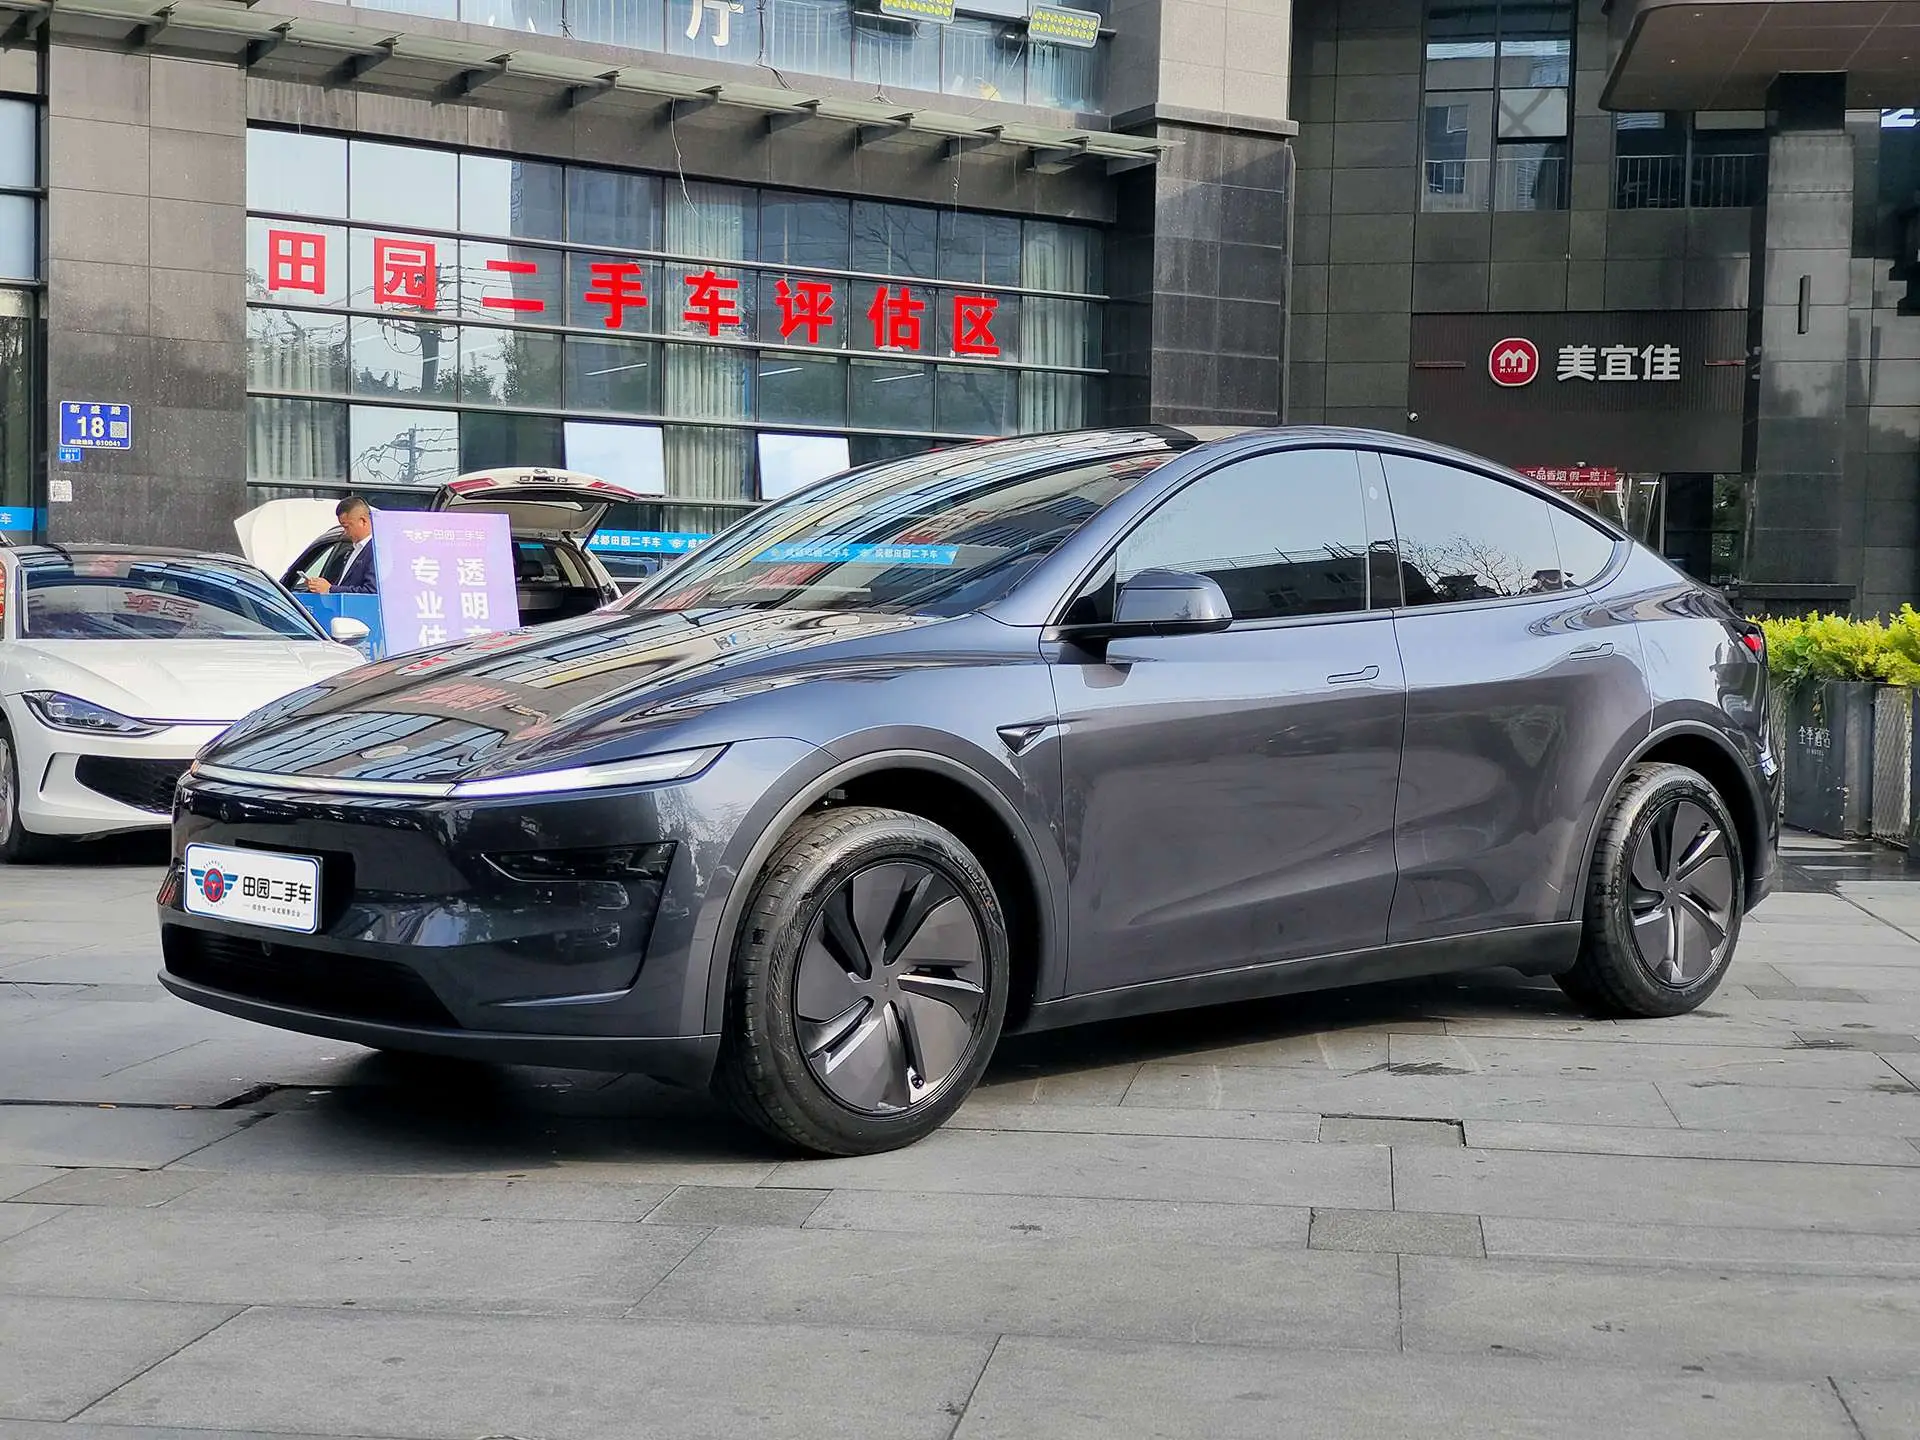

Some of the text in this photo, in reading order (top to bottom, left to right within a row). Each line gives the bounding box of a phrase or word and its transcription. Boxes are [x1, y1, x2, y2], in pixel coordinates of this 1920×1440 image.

[268, 229, 1000, 356] 田园二手车评估区
[1556, 344, 1681, 381] 美宜佳
[77, 416, 105, 438] 18
[433, 529, 486, 541] 田园二手车
[590, 534, 661, 548] 成都田园二手车
[243, 876, 312, 904] 田园二手车
